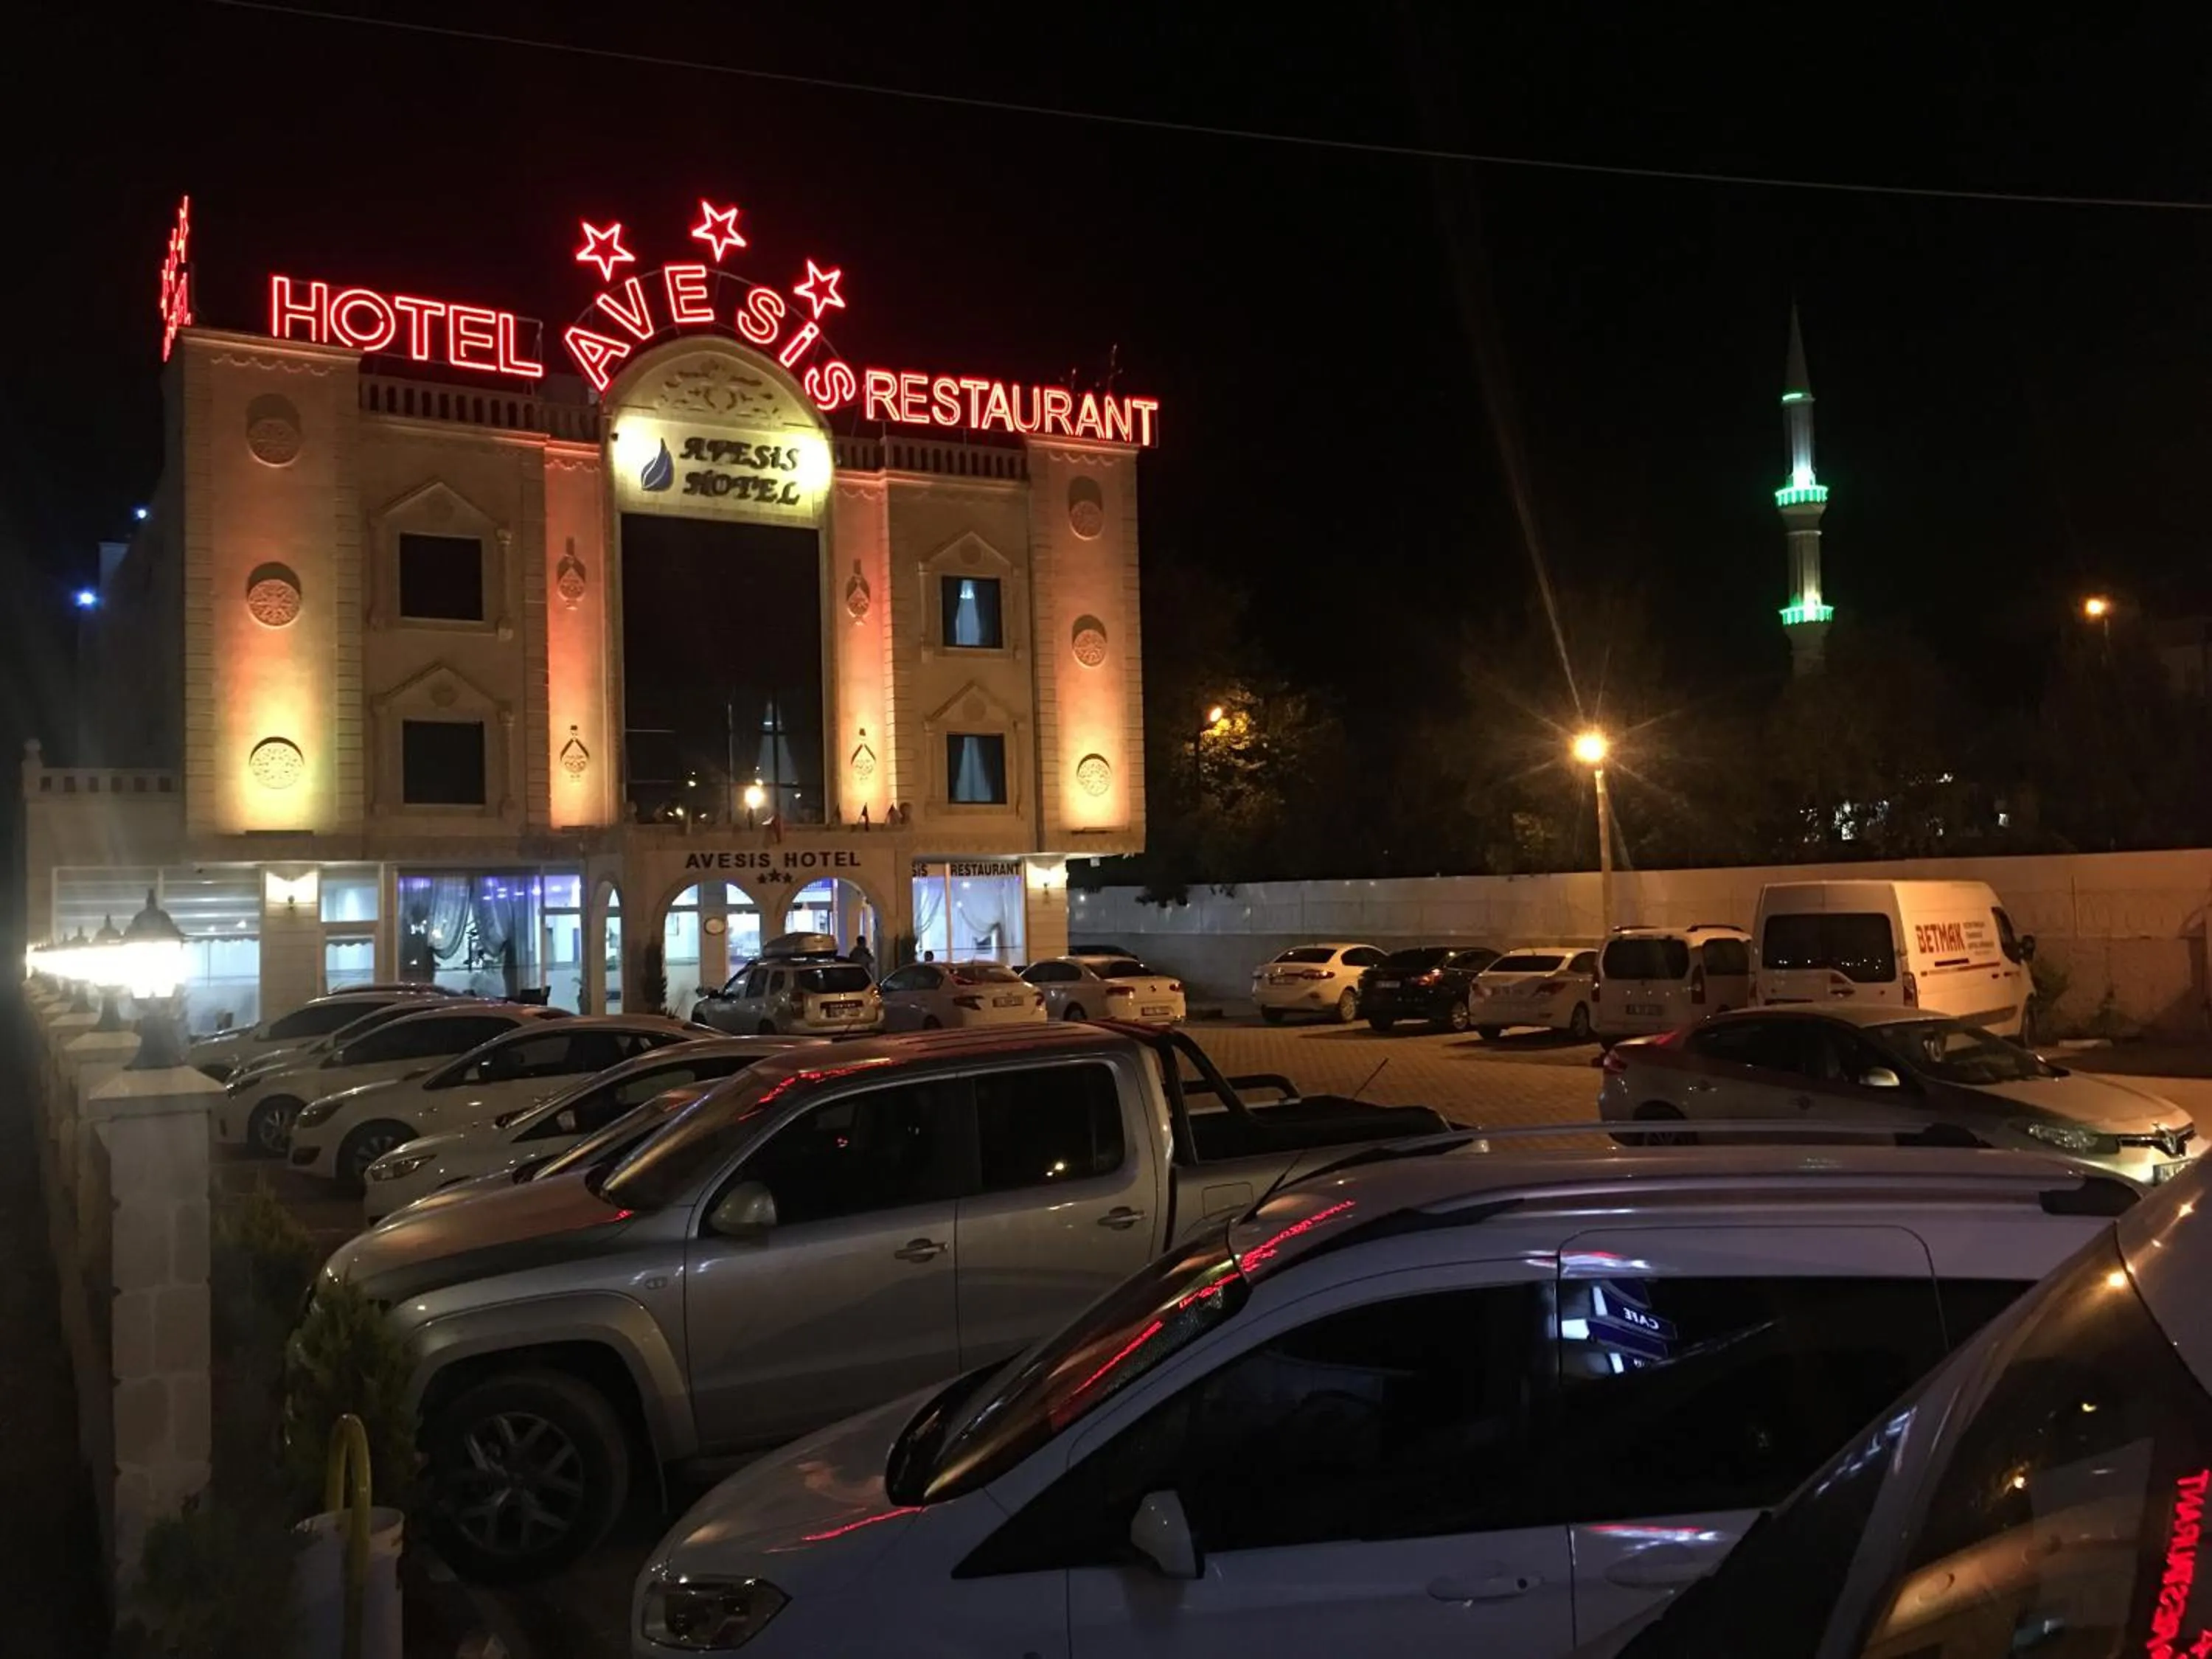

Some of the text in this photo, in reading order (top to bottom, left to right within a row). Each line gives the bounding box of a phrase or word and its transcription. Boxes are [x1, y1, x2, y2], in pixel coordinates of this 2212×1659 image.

[271, 274, 545, 378] HOTEL
[864, 368, 1160, 447] RESTAURANT
[682, 469, 801, 506] HOTEL
[784, 851, 861, 867] HOTEL
[950, 861, 1020, 877] RESTAURANT
